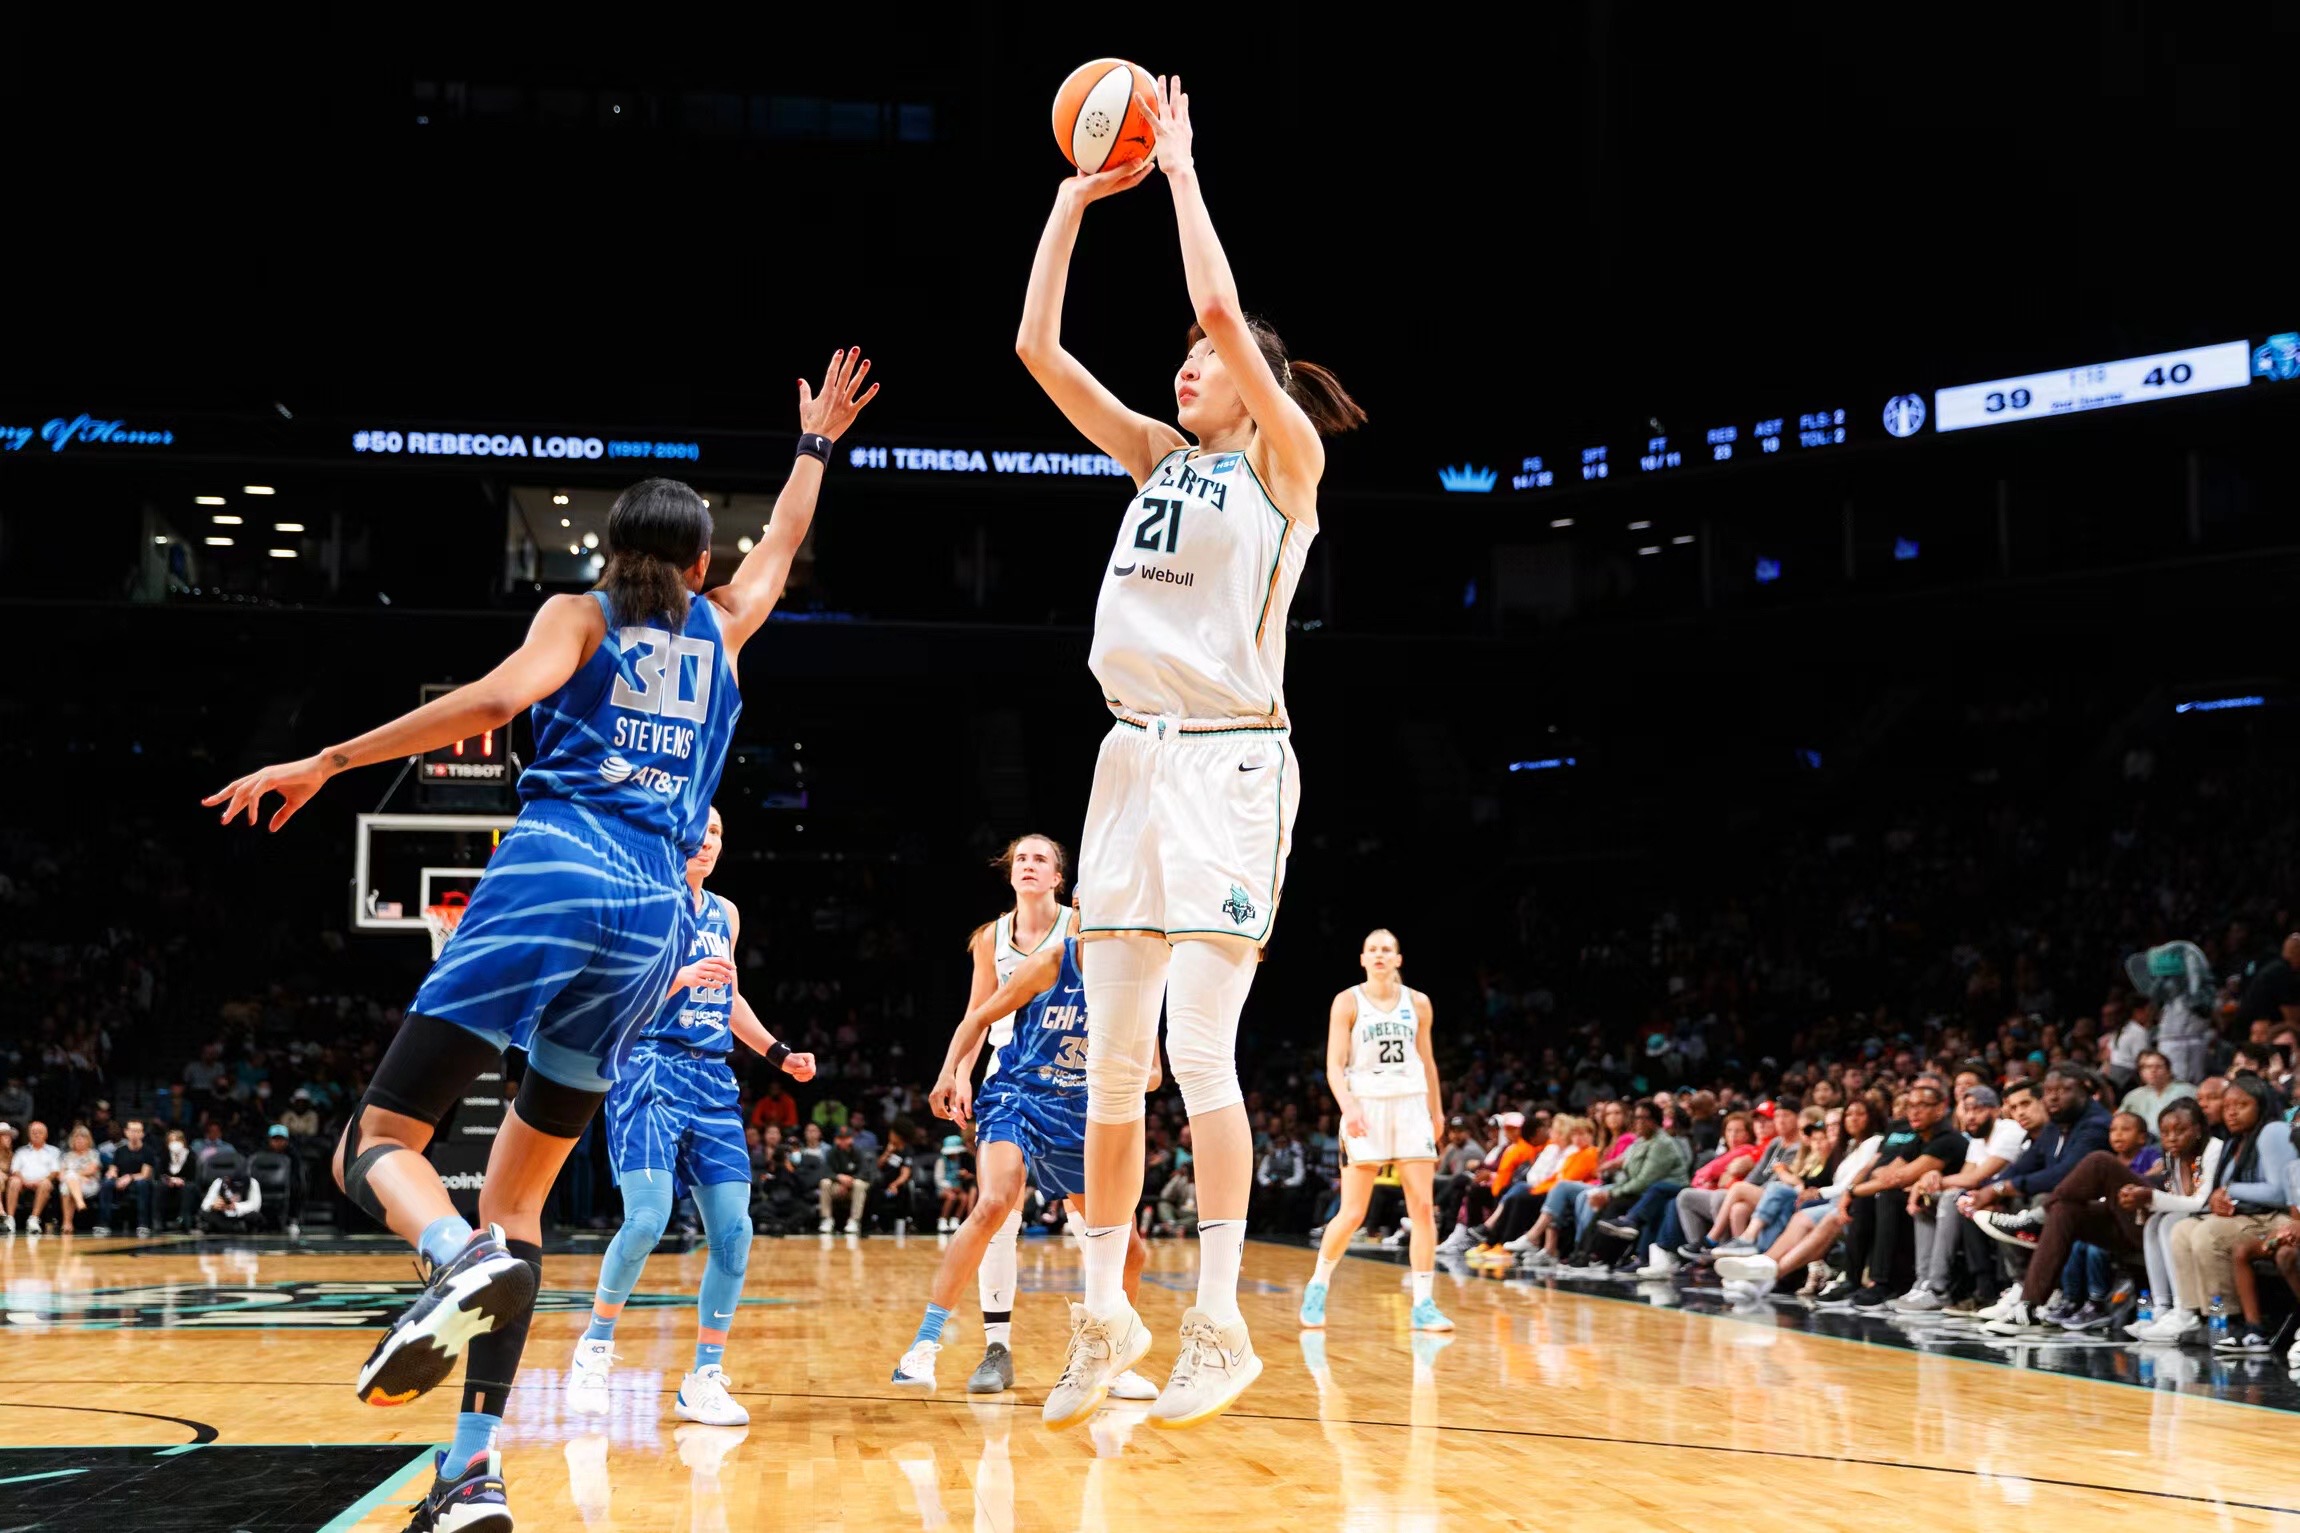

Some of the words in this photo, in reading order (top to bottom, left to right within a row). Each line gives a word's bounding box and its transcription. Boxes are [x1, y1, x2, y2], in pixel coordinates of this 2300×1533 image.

[2144, 363, 2192, 387] 40
[1985, 389, 2031, 412] 39
[353, 430, 403, 453] #50
[407, 432, 528, 457] REBECCA
[533, 436, 604, 459] LOBO
[850, 446, 887, 469] #11
[892, 448, 987, 472] TERESA
[1133, 497, 1184, 554] 21
[1141, 565, 1194, 587] Webull
[610, 626, 715, 724] 30
[614, 716, 694, 760] STEVENS
[632, 766, 689, 795] AT&T
[1379, 1040, 1404, 1063] 23
